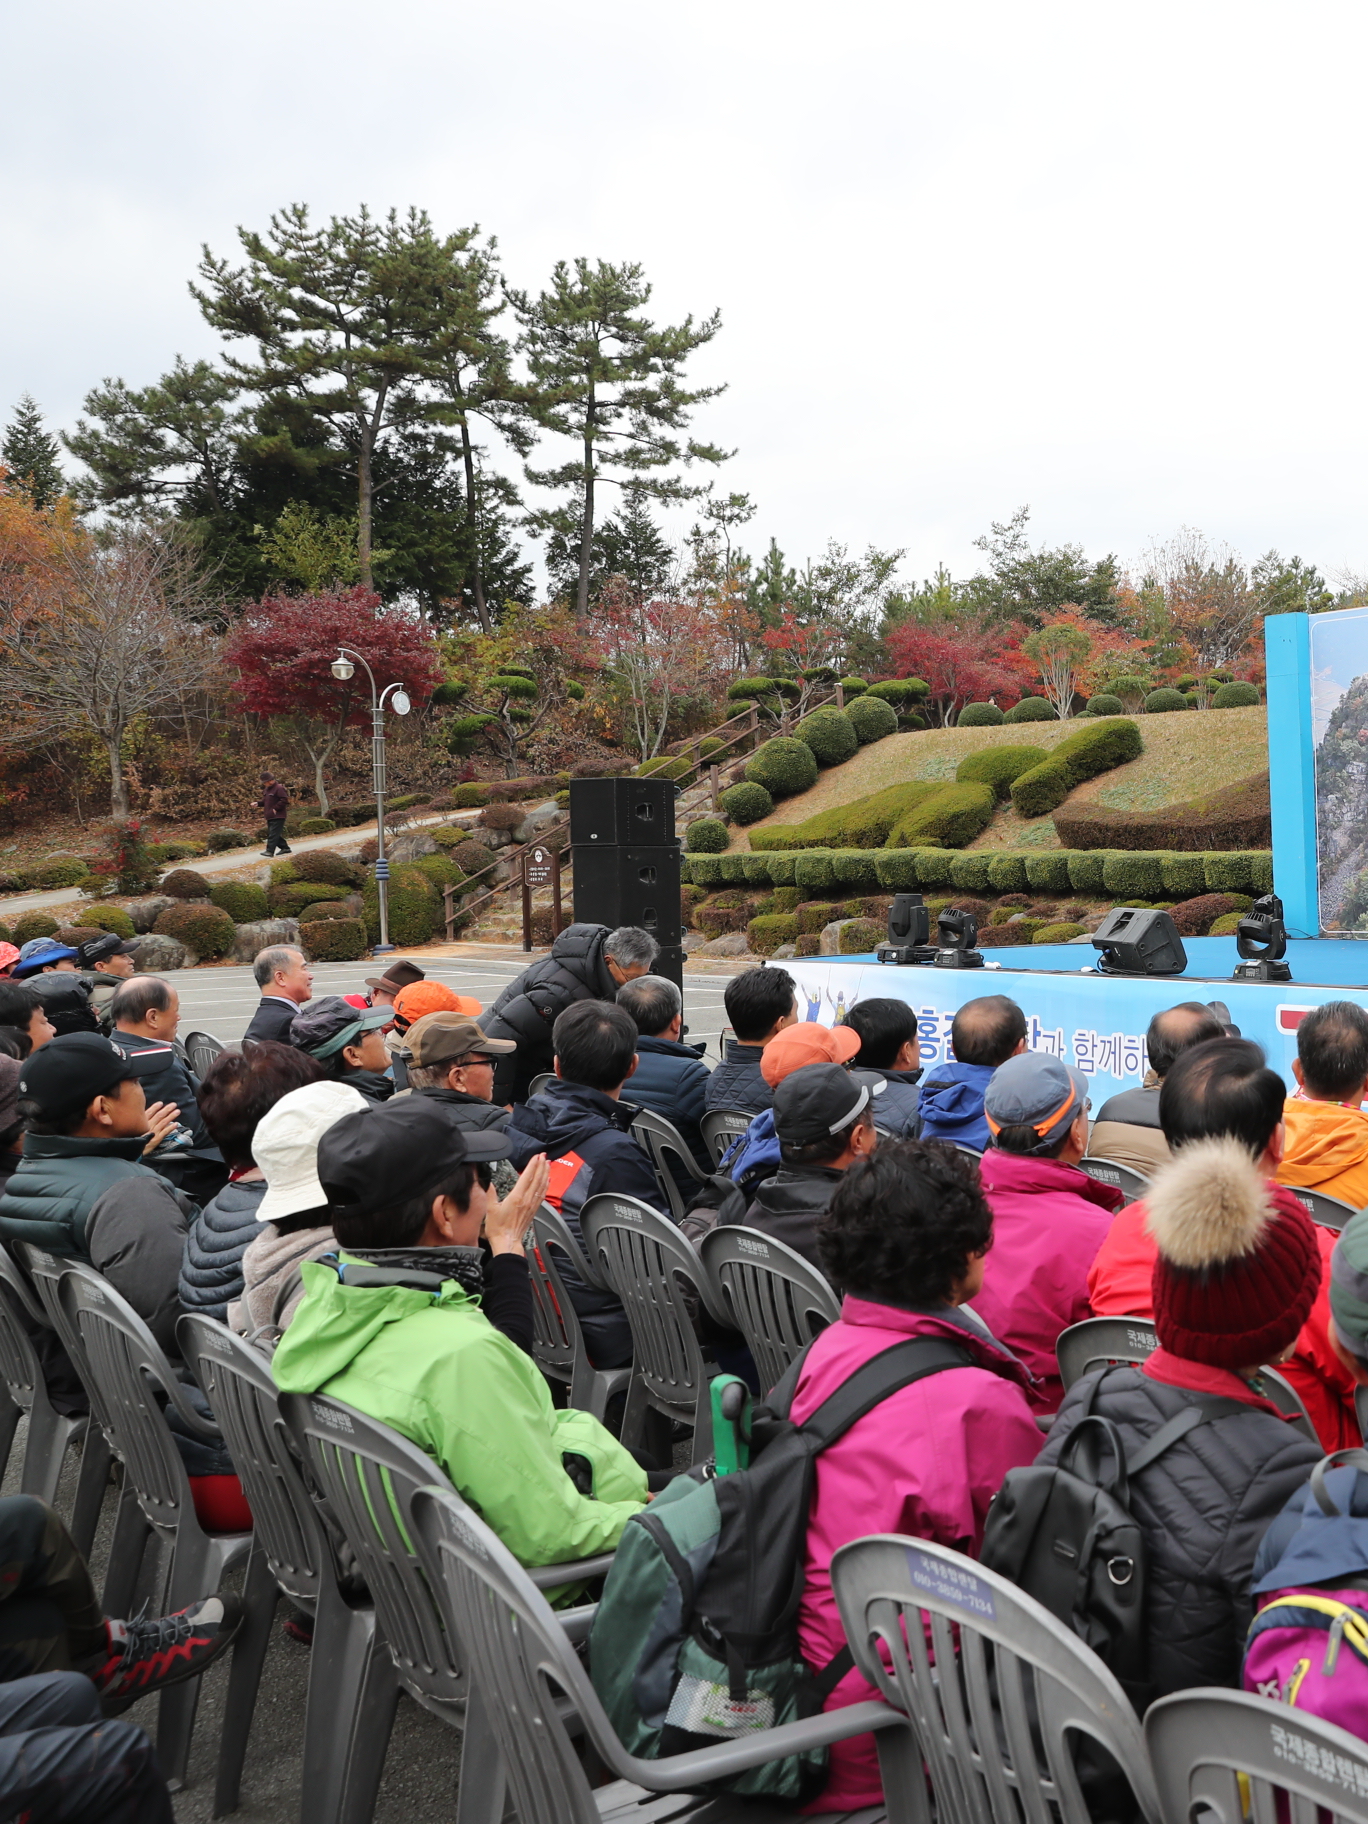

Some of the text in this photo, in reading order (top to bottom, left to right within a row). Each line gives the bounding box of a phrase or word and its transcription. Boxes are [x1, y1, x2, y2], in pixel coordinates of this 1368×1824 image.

[1073, 1030, 1150, 1079] 함께하
[1127, 1329, 1162, 1346] 국제종
[913, 1570, 993, 1616] 010-3859-7134
[919, 1555, 979, 1592] 국제종합렌탈
